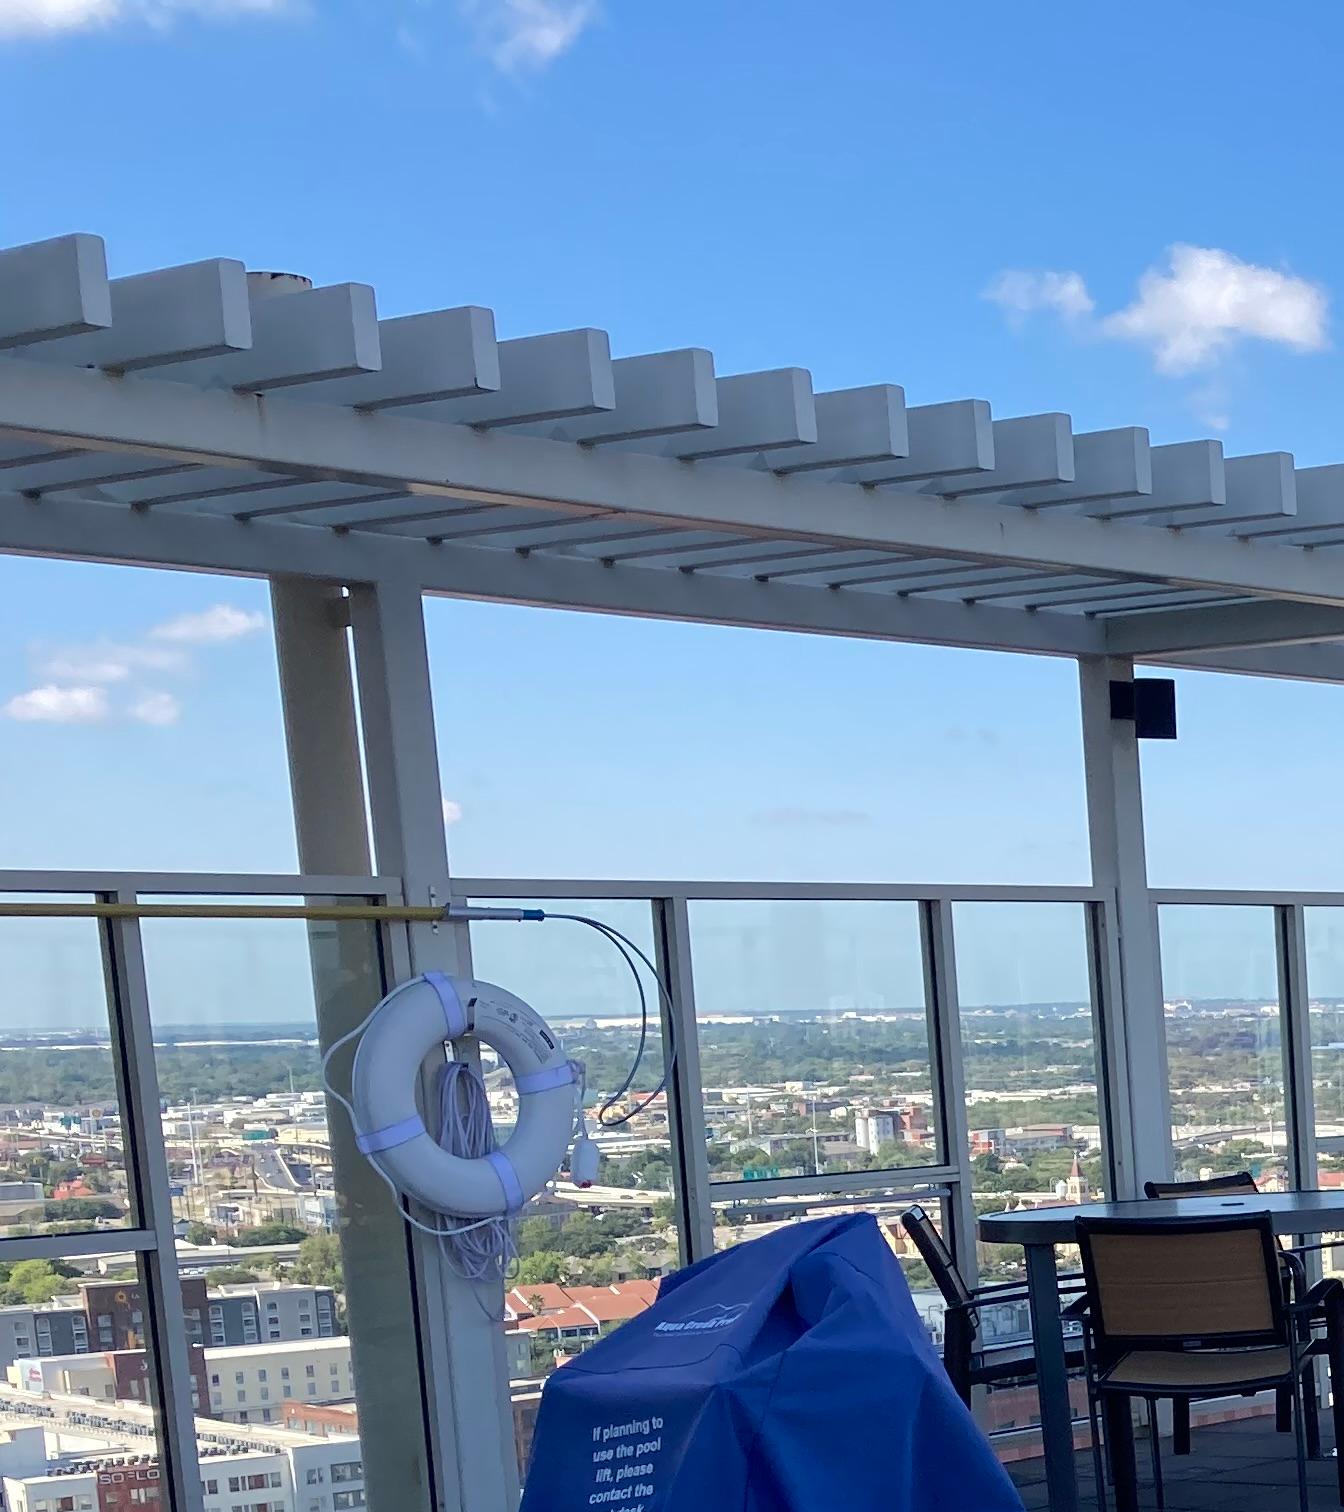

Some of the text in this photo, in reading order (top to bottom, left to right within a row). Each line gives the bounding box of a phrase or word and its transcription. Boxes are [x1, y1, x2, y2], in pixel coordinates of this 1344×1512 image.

[592, 1416, 664, 1443] If planning to
[592, 1436, 662, 1462] use the pool
[595, 1463, 654, 1483] lift, please
[588, 1483, 654, 1505] contact the
